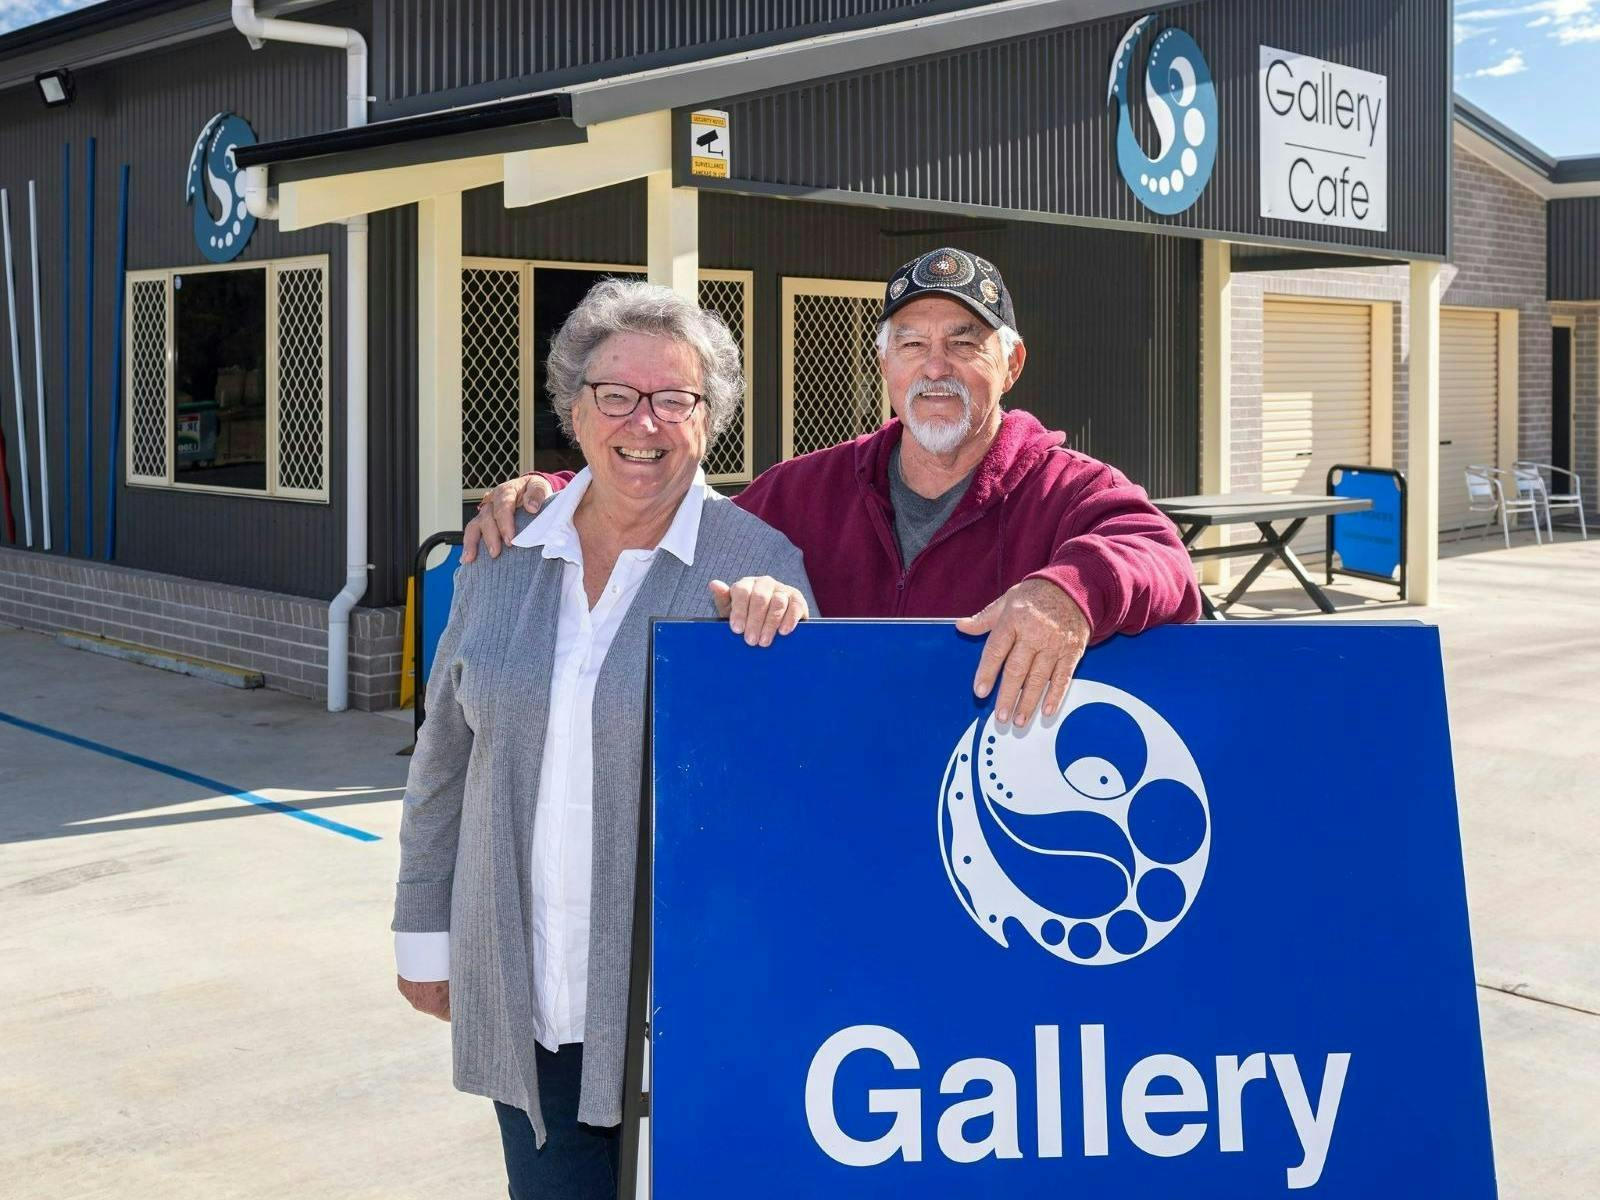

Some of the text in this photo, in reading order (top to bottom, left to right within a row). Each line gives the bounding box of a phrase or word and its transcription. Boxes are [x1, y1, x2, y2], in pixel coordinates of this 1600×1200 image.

[1266, 59, 1382, 147] Gallery
[1288, 157, 1369, 220] Cafe
[804, 1024, 1352, 1189] Gallery
